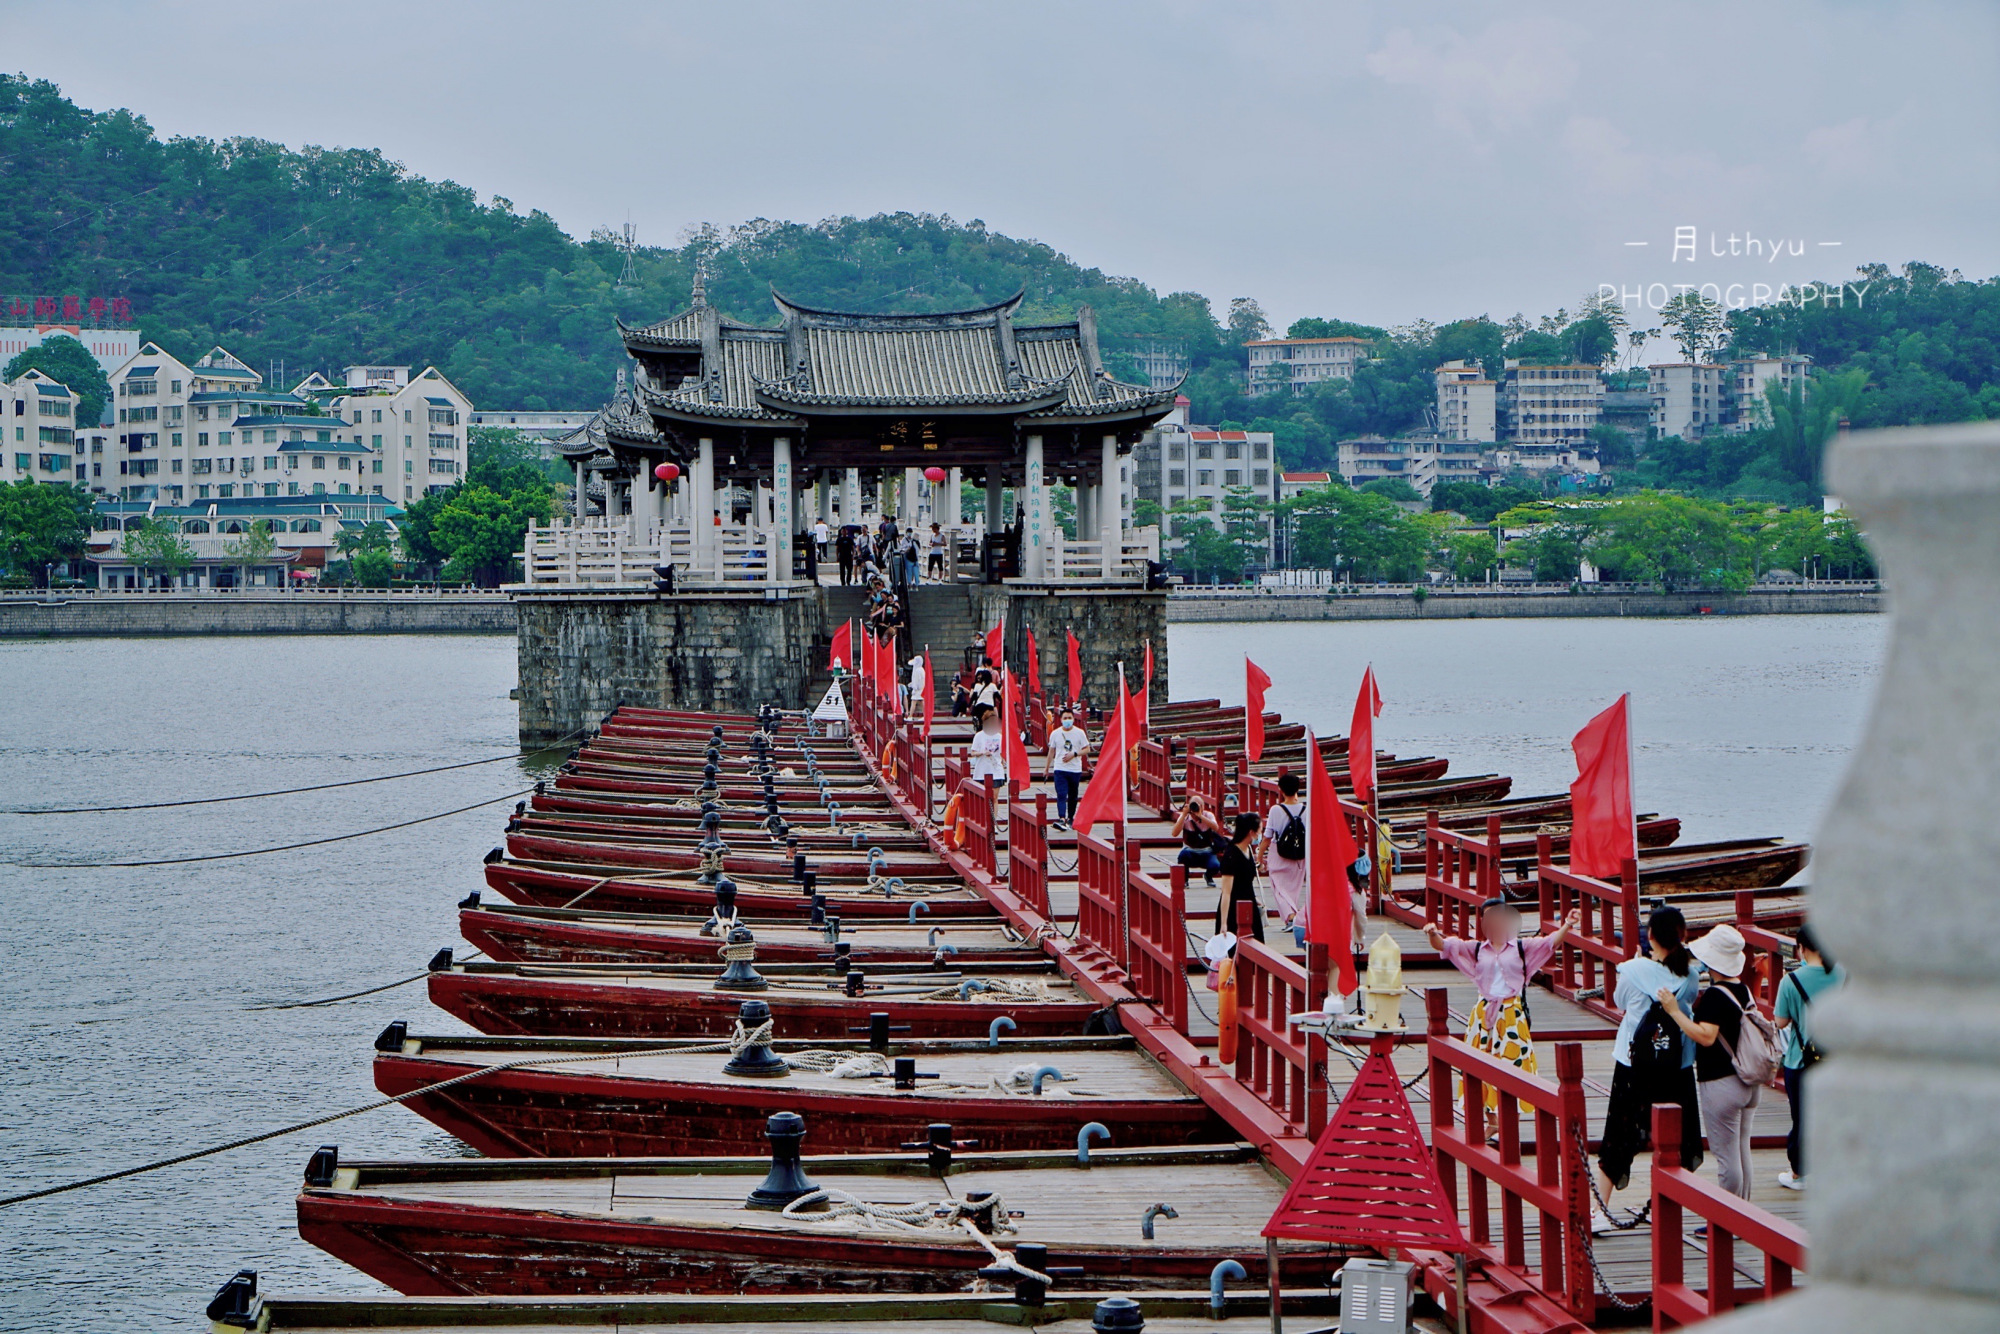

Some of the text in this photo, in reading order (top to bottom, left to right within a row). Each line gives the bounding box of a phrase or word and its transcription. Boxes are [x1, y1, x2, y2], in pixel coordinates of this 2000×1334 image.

[0, 295, 133, 322] 山師範學院
[825, 695, 840, 706] 51
